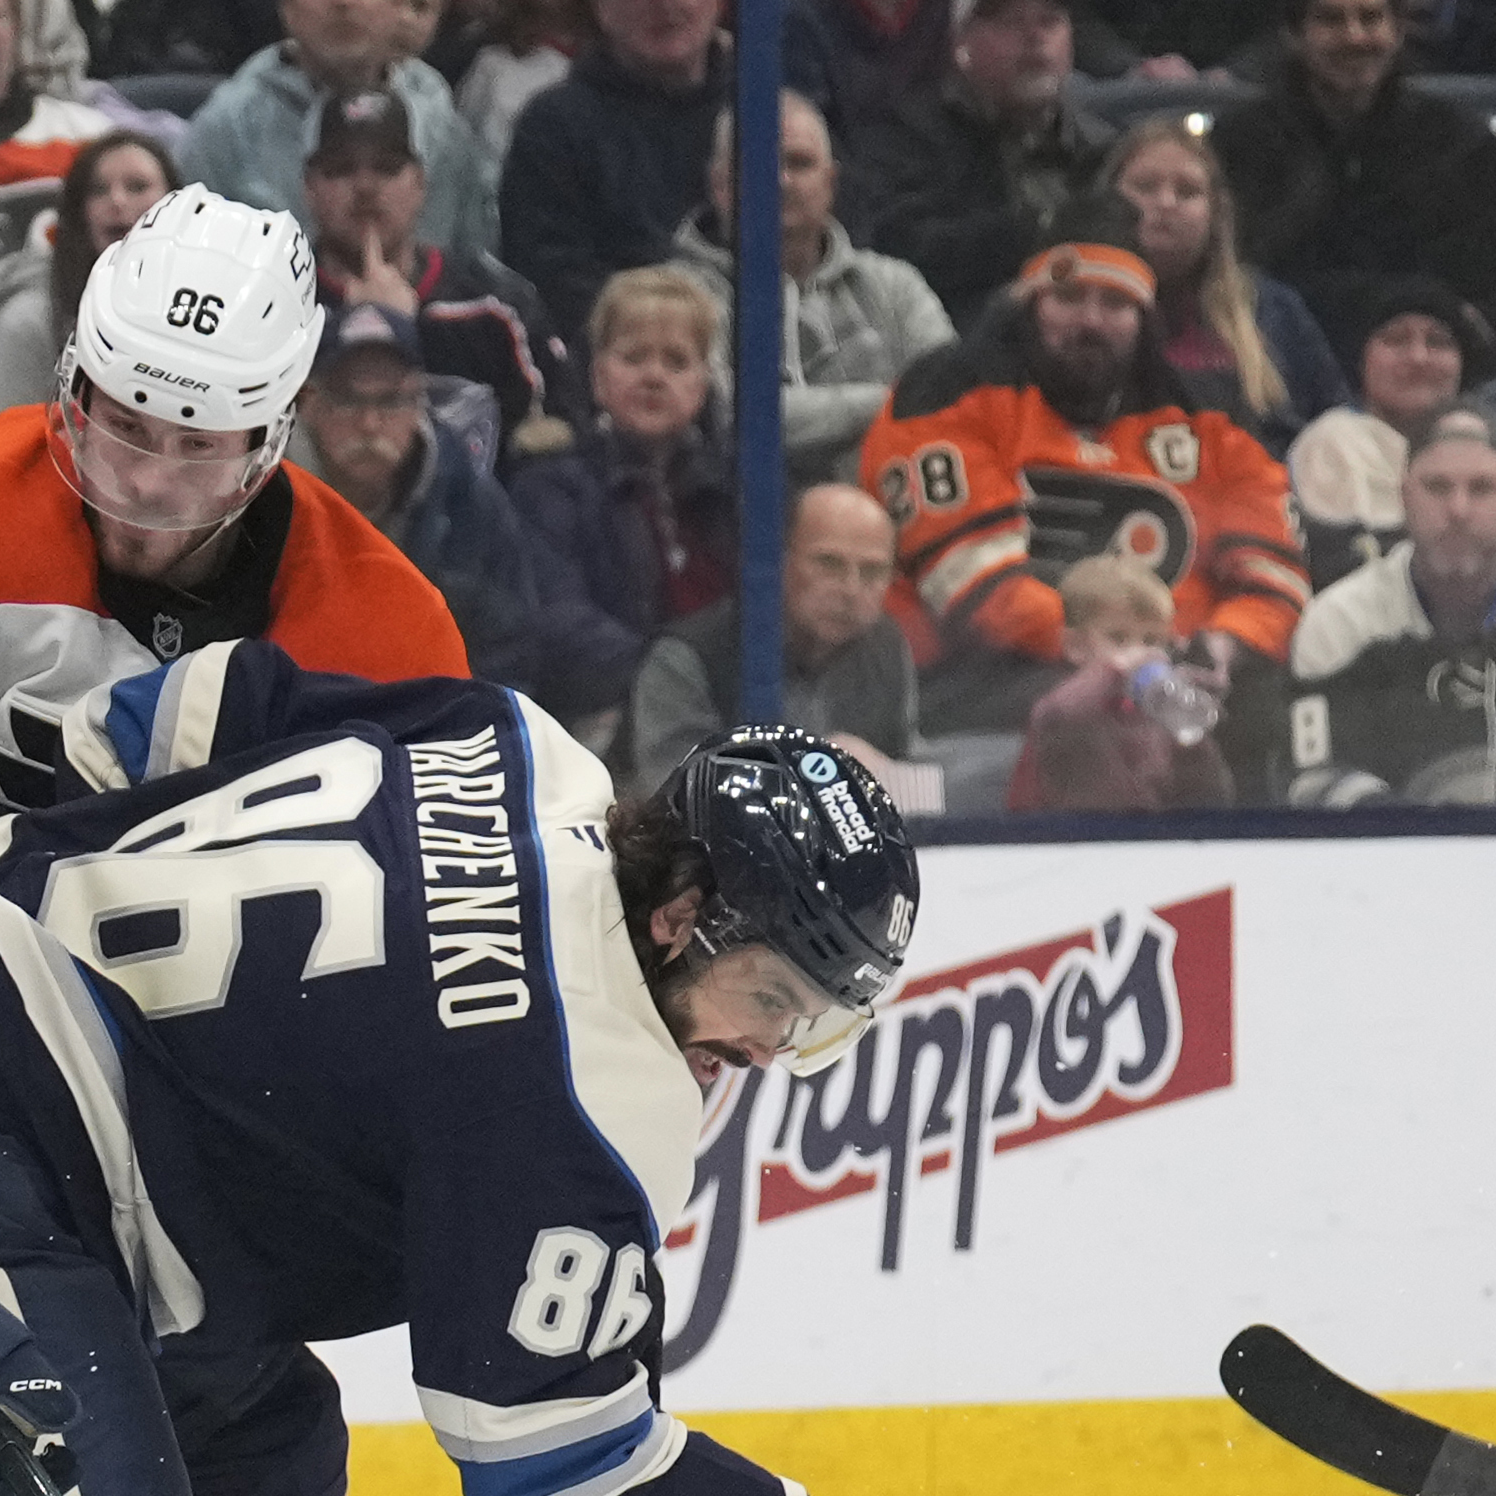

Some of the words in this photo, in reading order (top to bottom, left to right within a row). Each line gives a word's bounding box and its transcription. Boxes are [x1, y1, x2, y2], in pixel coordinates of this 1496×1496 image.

[167, 288, 225, 336] 86
[133, 362, 212, 393] BAUER
[817, 786, 863, 854] financial
[831, 780, 876, 842] bread
[887, 894, 914, 947] 86
[507, 1225, 653, 1361] 86
[10, 1379, 62, 1392] CCM
